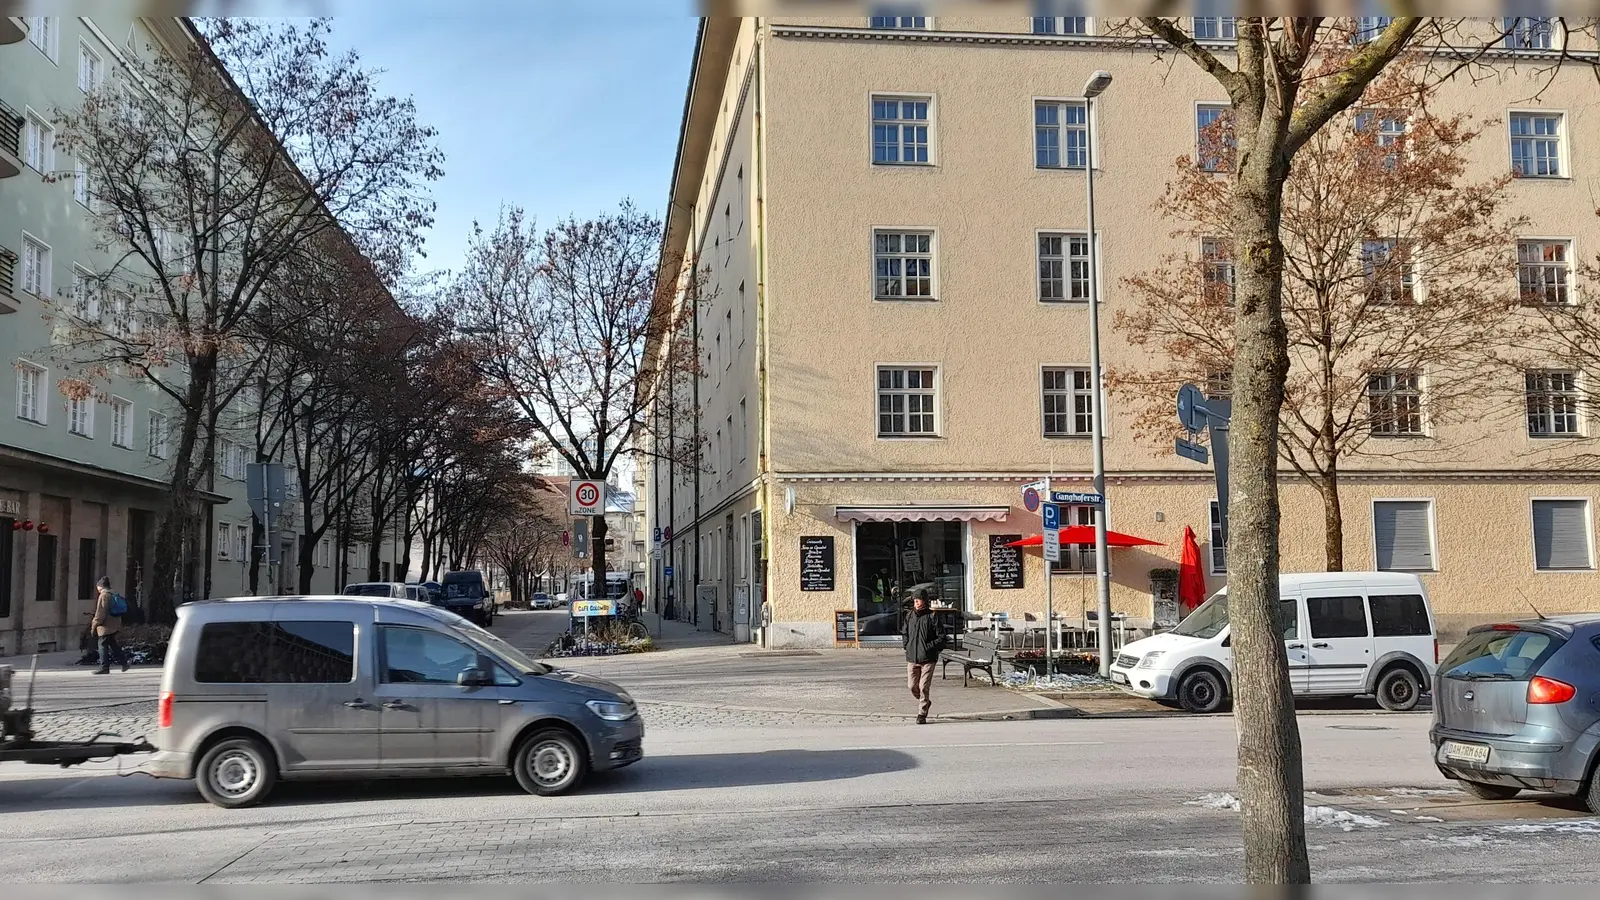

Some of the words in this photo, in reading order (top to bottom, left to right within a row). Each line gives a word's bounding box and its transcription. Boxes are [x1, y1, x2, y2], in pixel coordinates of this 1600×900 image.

[580, 489, 595, 500] 30
[1055, 492, 1103, 504] Ganghoferstr.
[1448, 743, 1462, 755] DAH
[1474, 747, 1487, 759] 684
